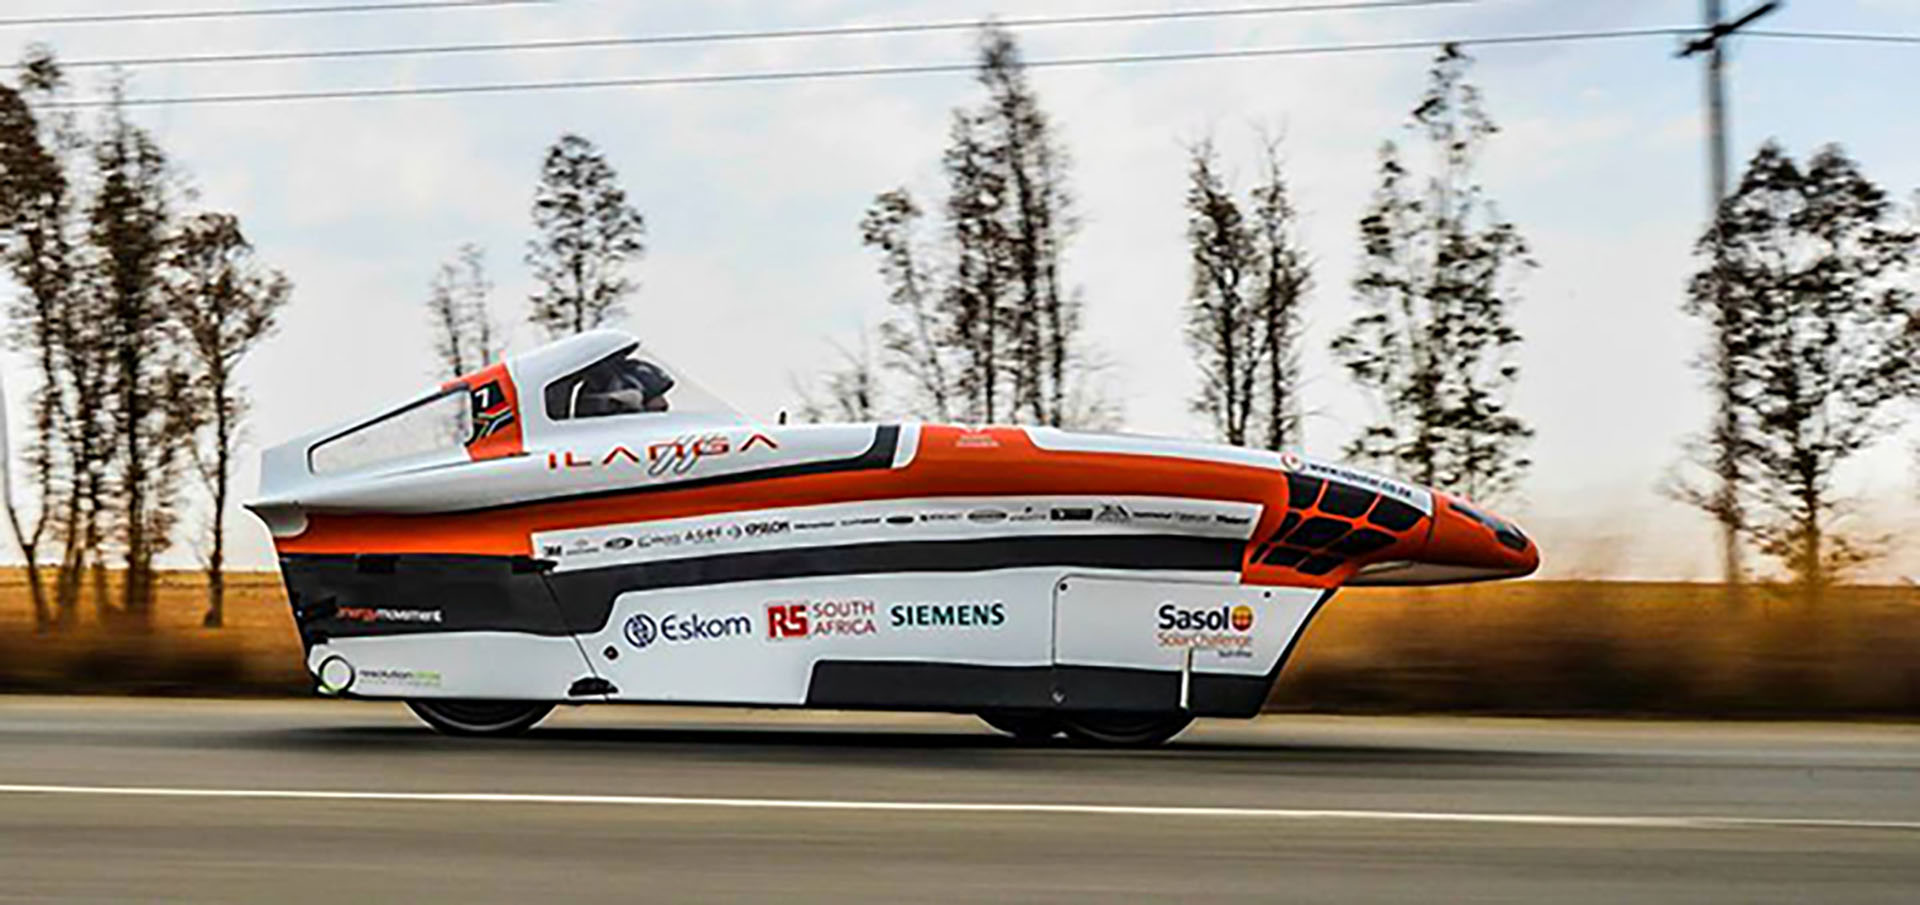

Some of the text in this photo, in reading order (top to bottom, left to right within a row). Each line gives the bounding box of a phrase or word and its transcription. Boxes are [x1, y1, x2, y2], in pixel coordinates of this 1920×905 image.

[767, 604, 808, 639] RS
[812, 600, 875, 618] SOUTH
[890, 603, 1005, 626] SIEMENS
[1158, 604, 1229, 631] Sasol
[660, 613, 751, 641] Eskom
[813, 619, 876, 636] AFRICA
